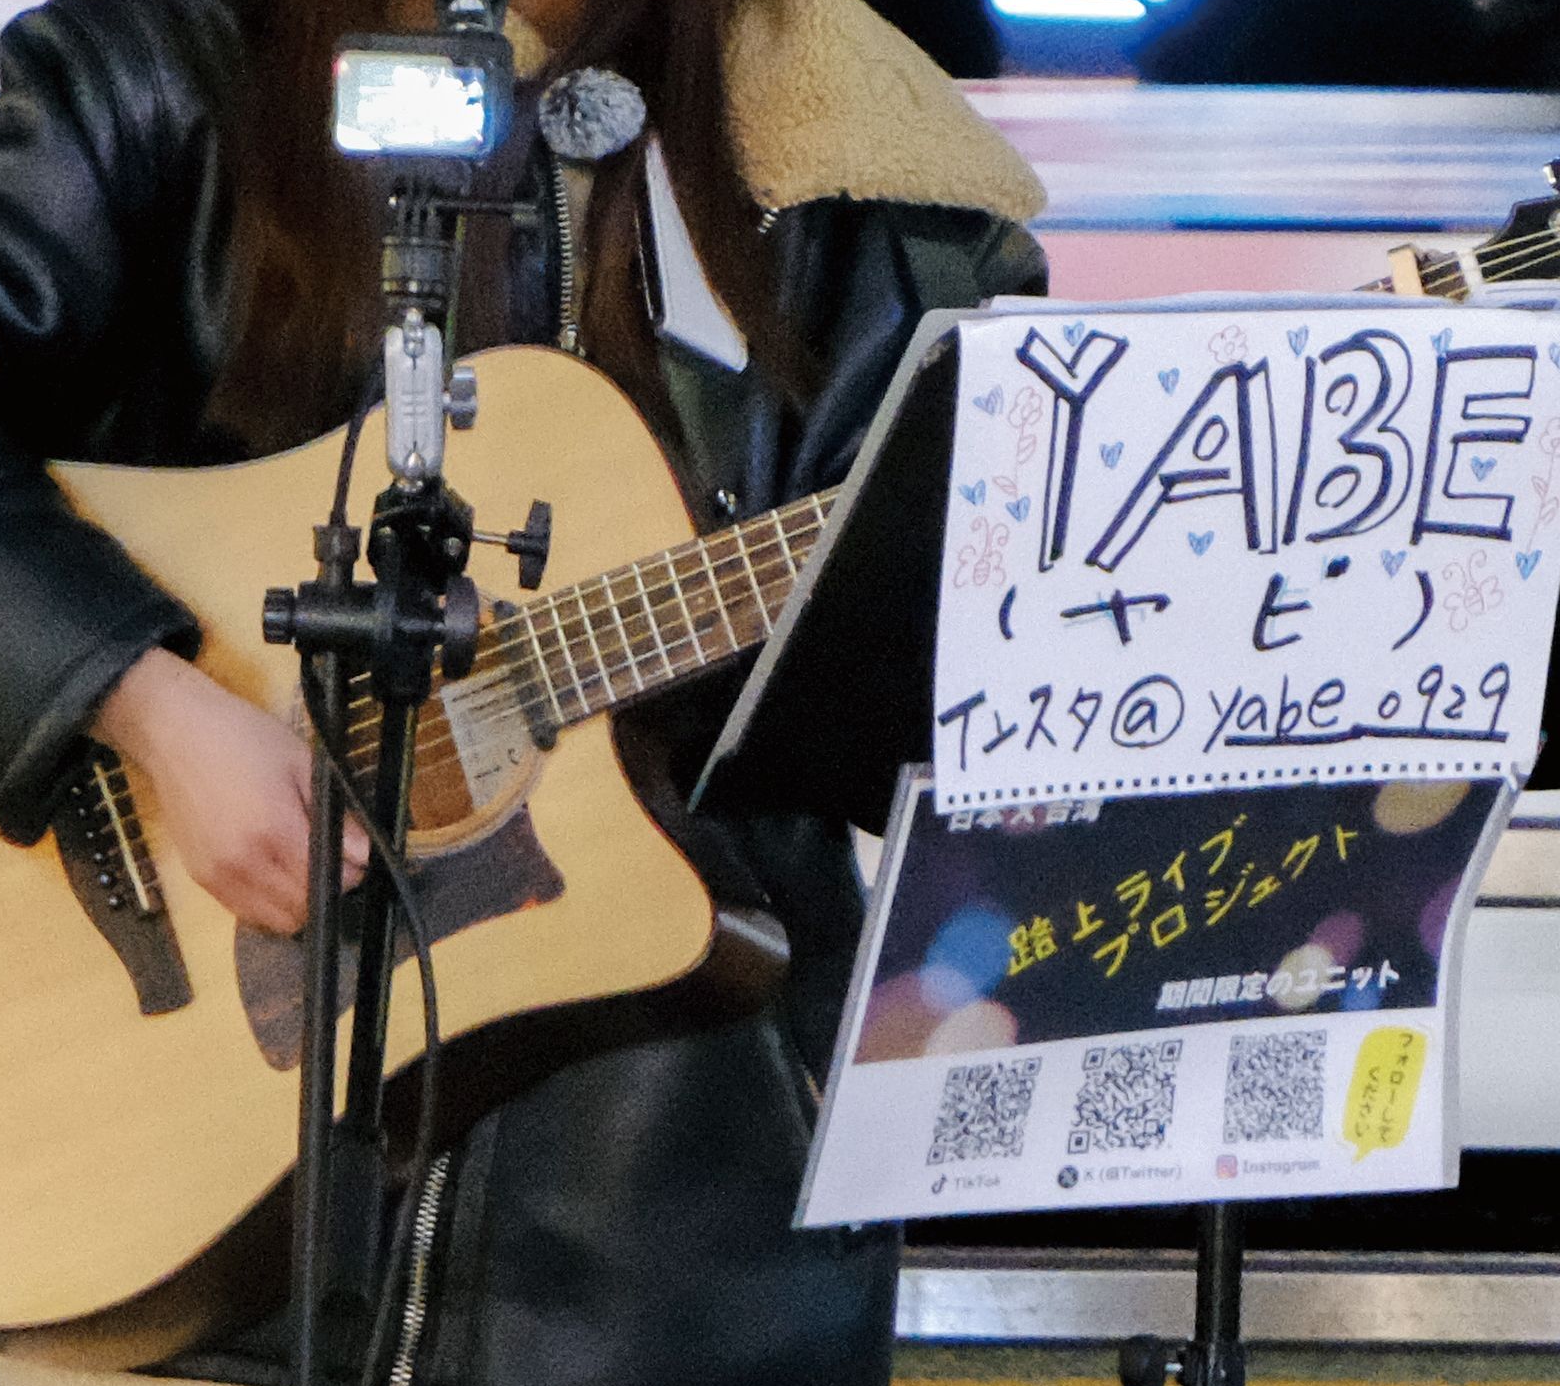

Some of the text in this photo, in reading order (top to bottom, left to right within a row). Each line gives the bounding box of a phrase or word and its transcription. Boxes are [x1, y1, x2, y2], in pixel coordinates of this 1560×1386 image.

[1017, 327, 1538, 573] YABE
[1092, 824, 1359, 979] プロジェクト
[953, 1173, 1002, 1192] TikTok
[1242, 1157, 1322, 1179] Instagram
